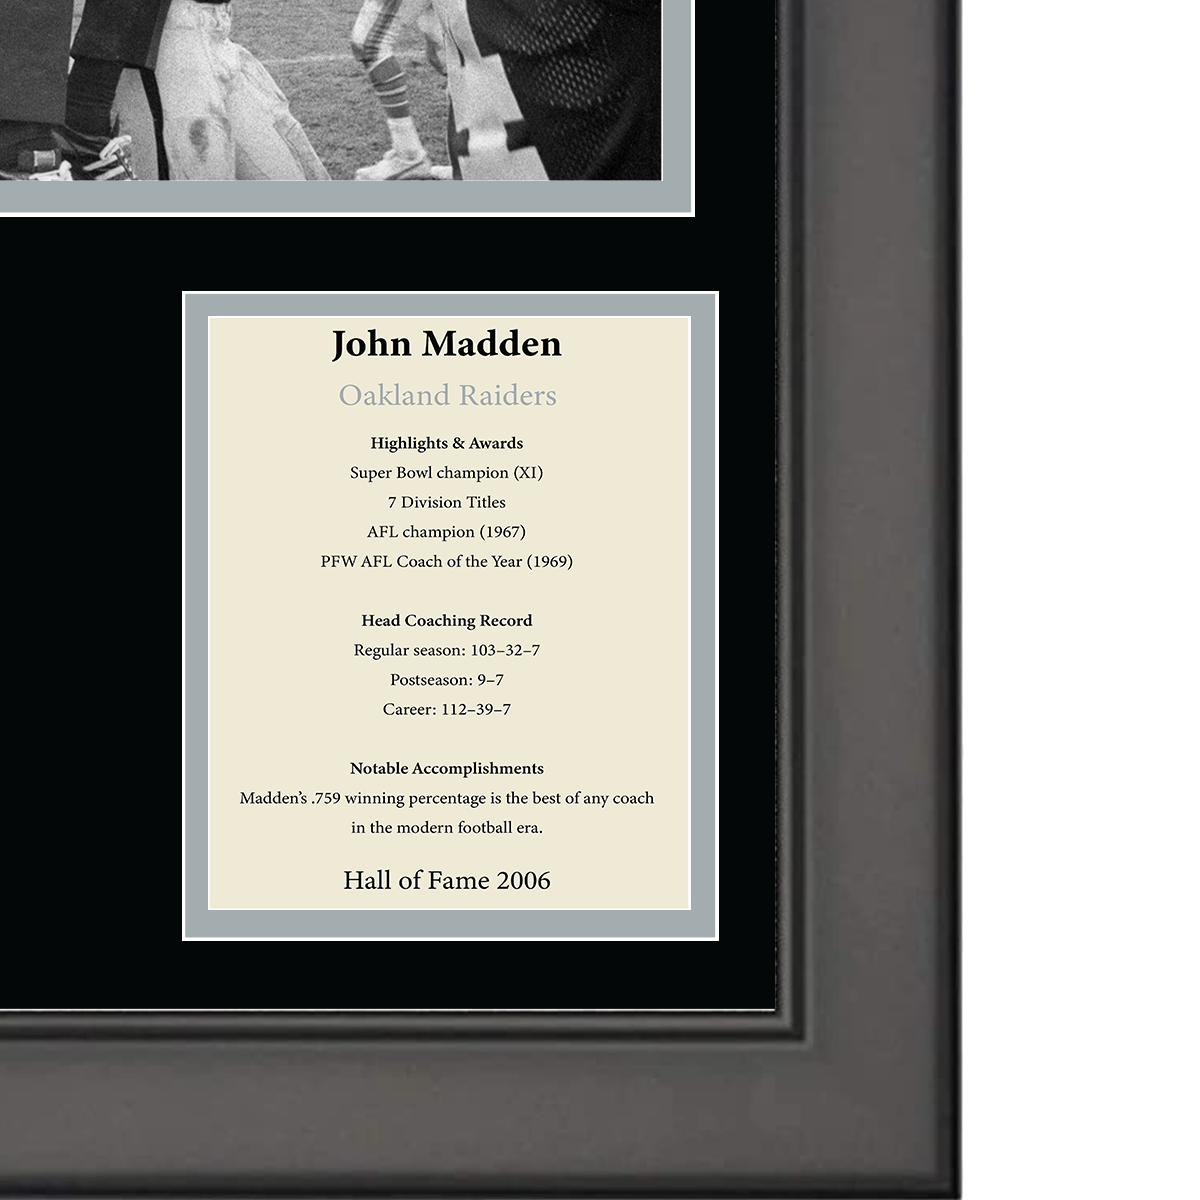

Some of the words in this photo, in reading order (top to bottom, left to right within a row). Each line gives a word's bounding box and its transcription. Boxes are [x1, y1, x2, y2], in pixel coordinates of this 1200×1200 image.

[332, 329, 412, 362] John
[422, 329, 562, 357] Madden
[340, 382, 450, 406] Oakland
[460, 382, 557, 406] Raiders
[371, 436, 448, 453] Highlights
[453, 437, 466, 450] &
[469, 436, 523, 450] Awards
[350, 466, 393, 482] Super
[397, 465, 433, 480] Bowl
[437, 465, 509, 482] champion
[513, 465, 544, 482] (XI)
[388, 496, 397, 509] 7
[402, 495, 462, 509] Division
[466, 495, 506, 509] Titles
[367, 525, 399, 539] AFL
[403, 525, 475, 542] champion
[479, 524, 526, 542] (1967)
[321, 555, 358, 568] PFW
[361, 555, 393, 568] AFL
[397, 554, 442, 568] Coach
[447, 554, 464, 568] of
[466, 554, 489, 568] the
[491, 554, 523, 568] Year
[527, 554, 574, 571] (1969)
[362, 613, 400, 627] Head
[405, 613, 476, 631] Coaching
[480, 613, 533, 628] Record
[354, 642, 410, 660] Regular
[414, 646, 466, 657] season:
[391, 673, 473, 687] Postseason:
[383, 702, 437, 716] Career:
[350, 761, 409, 775] Notable
[412, 761, 544, 779] Accomplishments
[311, 791, 341, 805] .759
[345, 791, 405, 808] winning
[409, 792, 487, 808] percentage
[490, 791, 502, 805] is
[506, 790, 529, 805] the
[533, 790, 561, 805] best
[565, 791, 582, 805] of
[583, 794, 610, 809] any
[613, 790, 655, 805] coach
[351, 820, 366, 834] in
[370, 820, 393, 834] the
[397, 820, 454, 834] modern
[458, 819, 512, 834] football
[517, 824, 543, 834] era.
[344, 869, 392, 890] Hall
[399, 869, 426, 890] of
[428, 870, 490, 890] Fame
[497, 870, 551, 890] 2006
